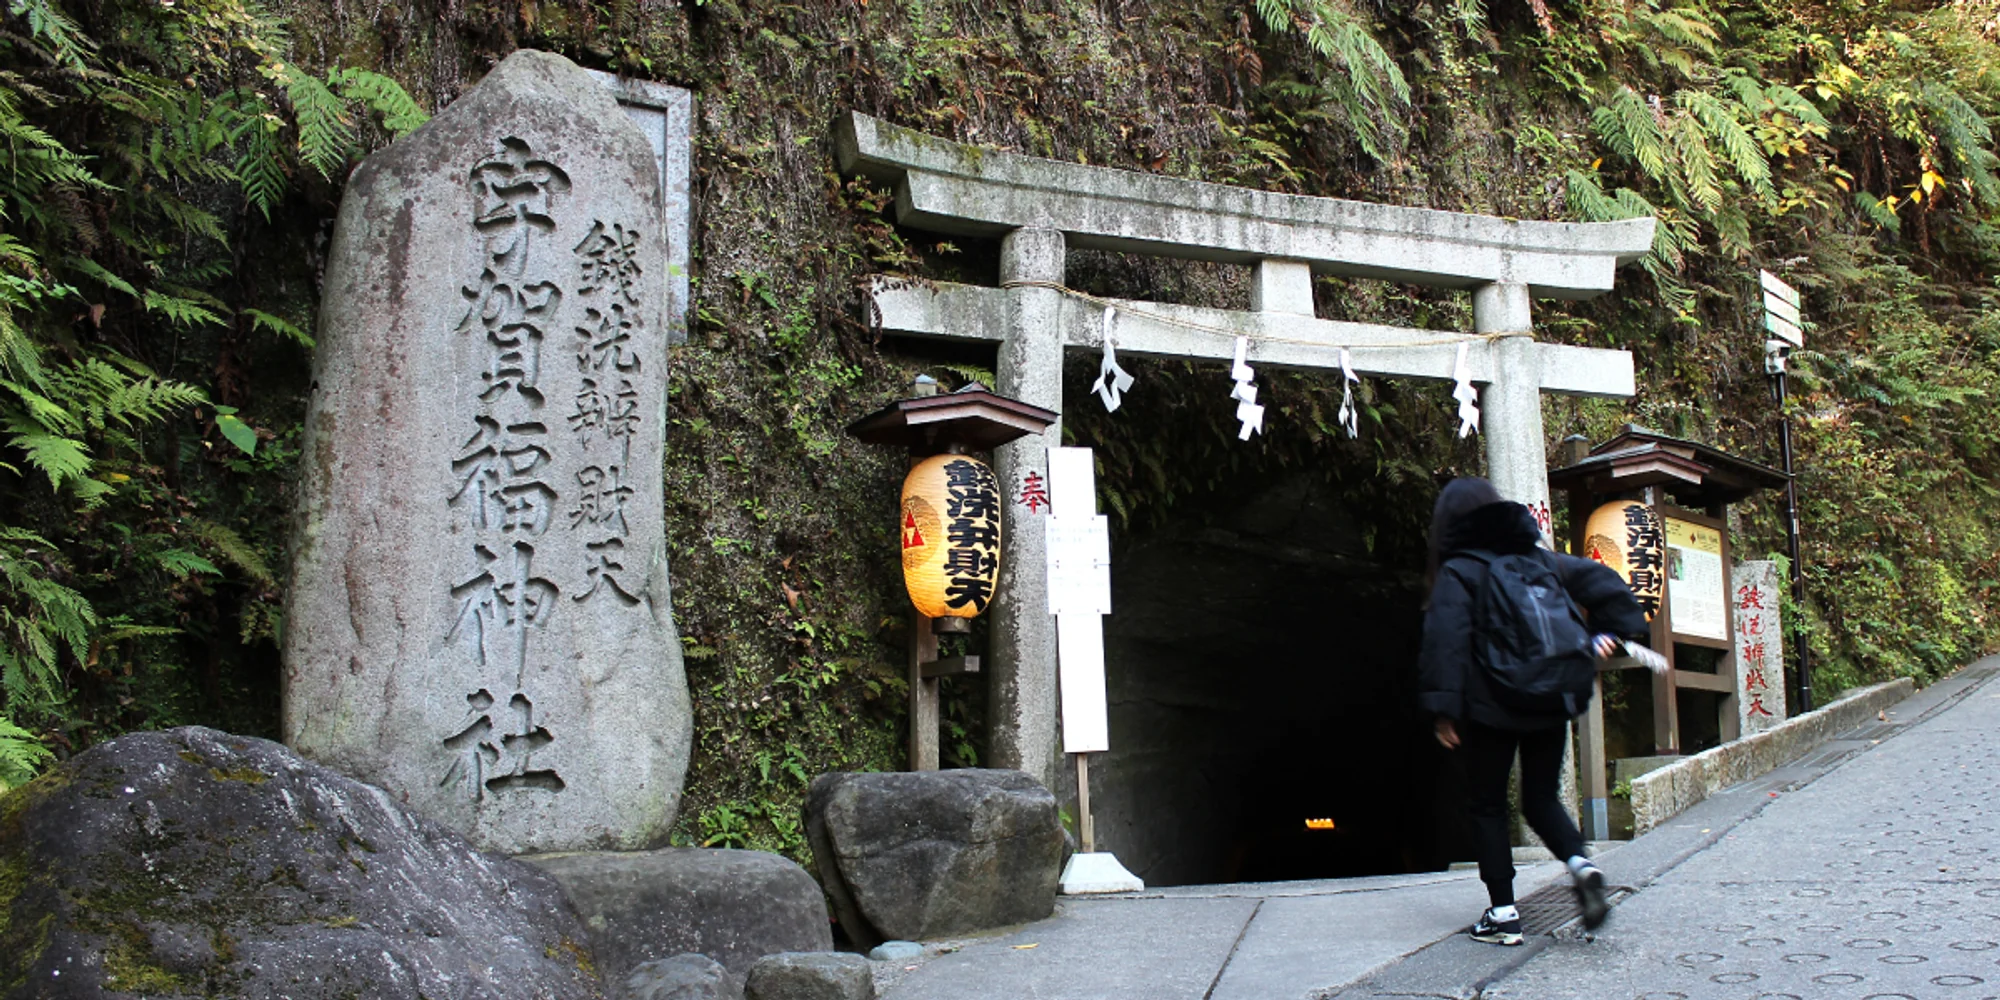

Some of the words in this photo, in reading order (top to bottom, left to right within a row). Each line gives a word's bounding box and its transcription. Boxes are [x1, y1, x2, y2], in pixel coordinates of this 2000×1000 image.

[440, 136, 572, 800] 宇賀福神社
[1017, 471, 1050, 515] 奉
